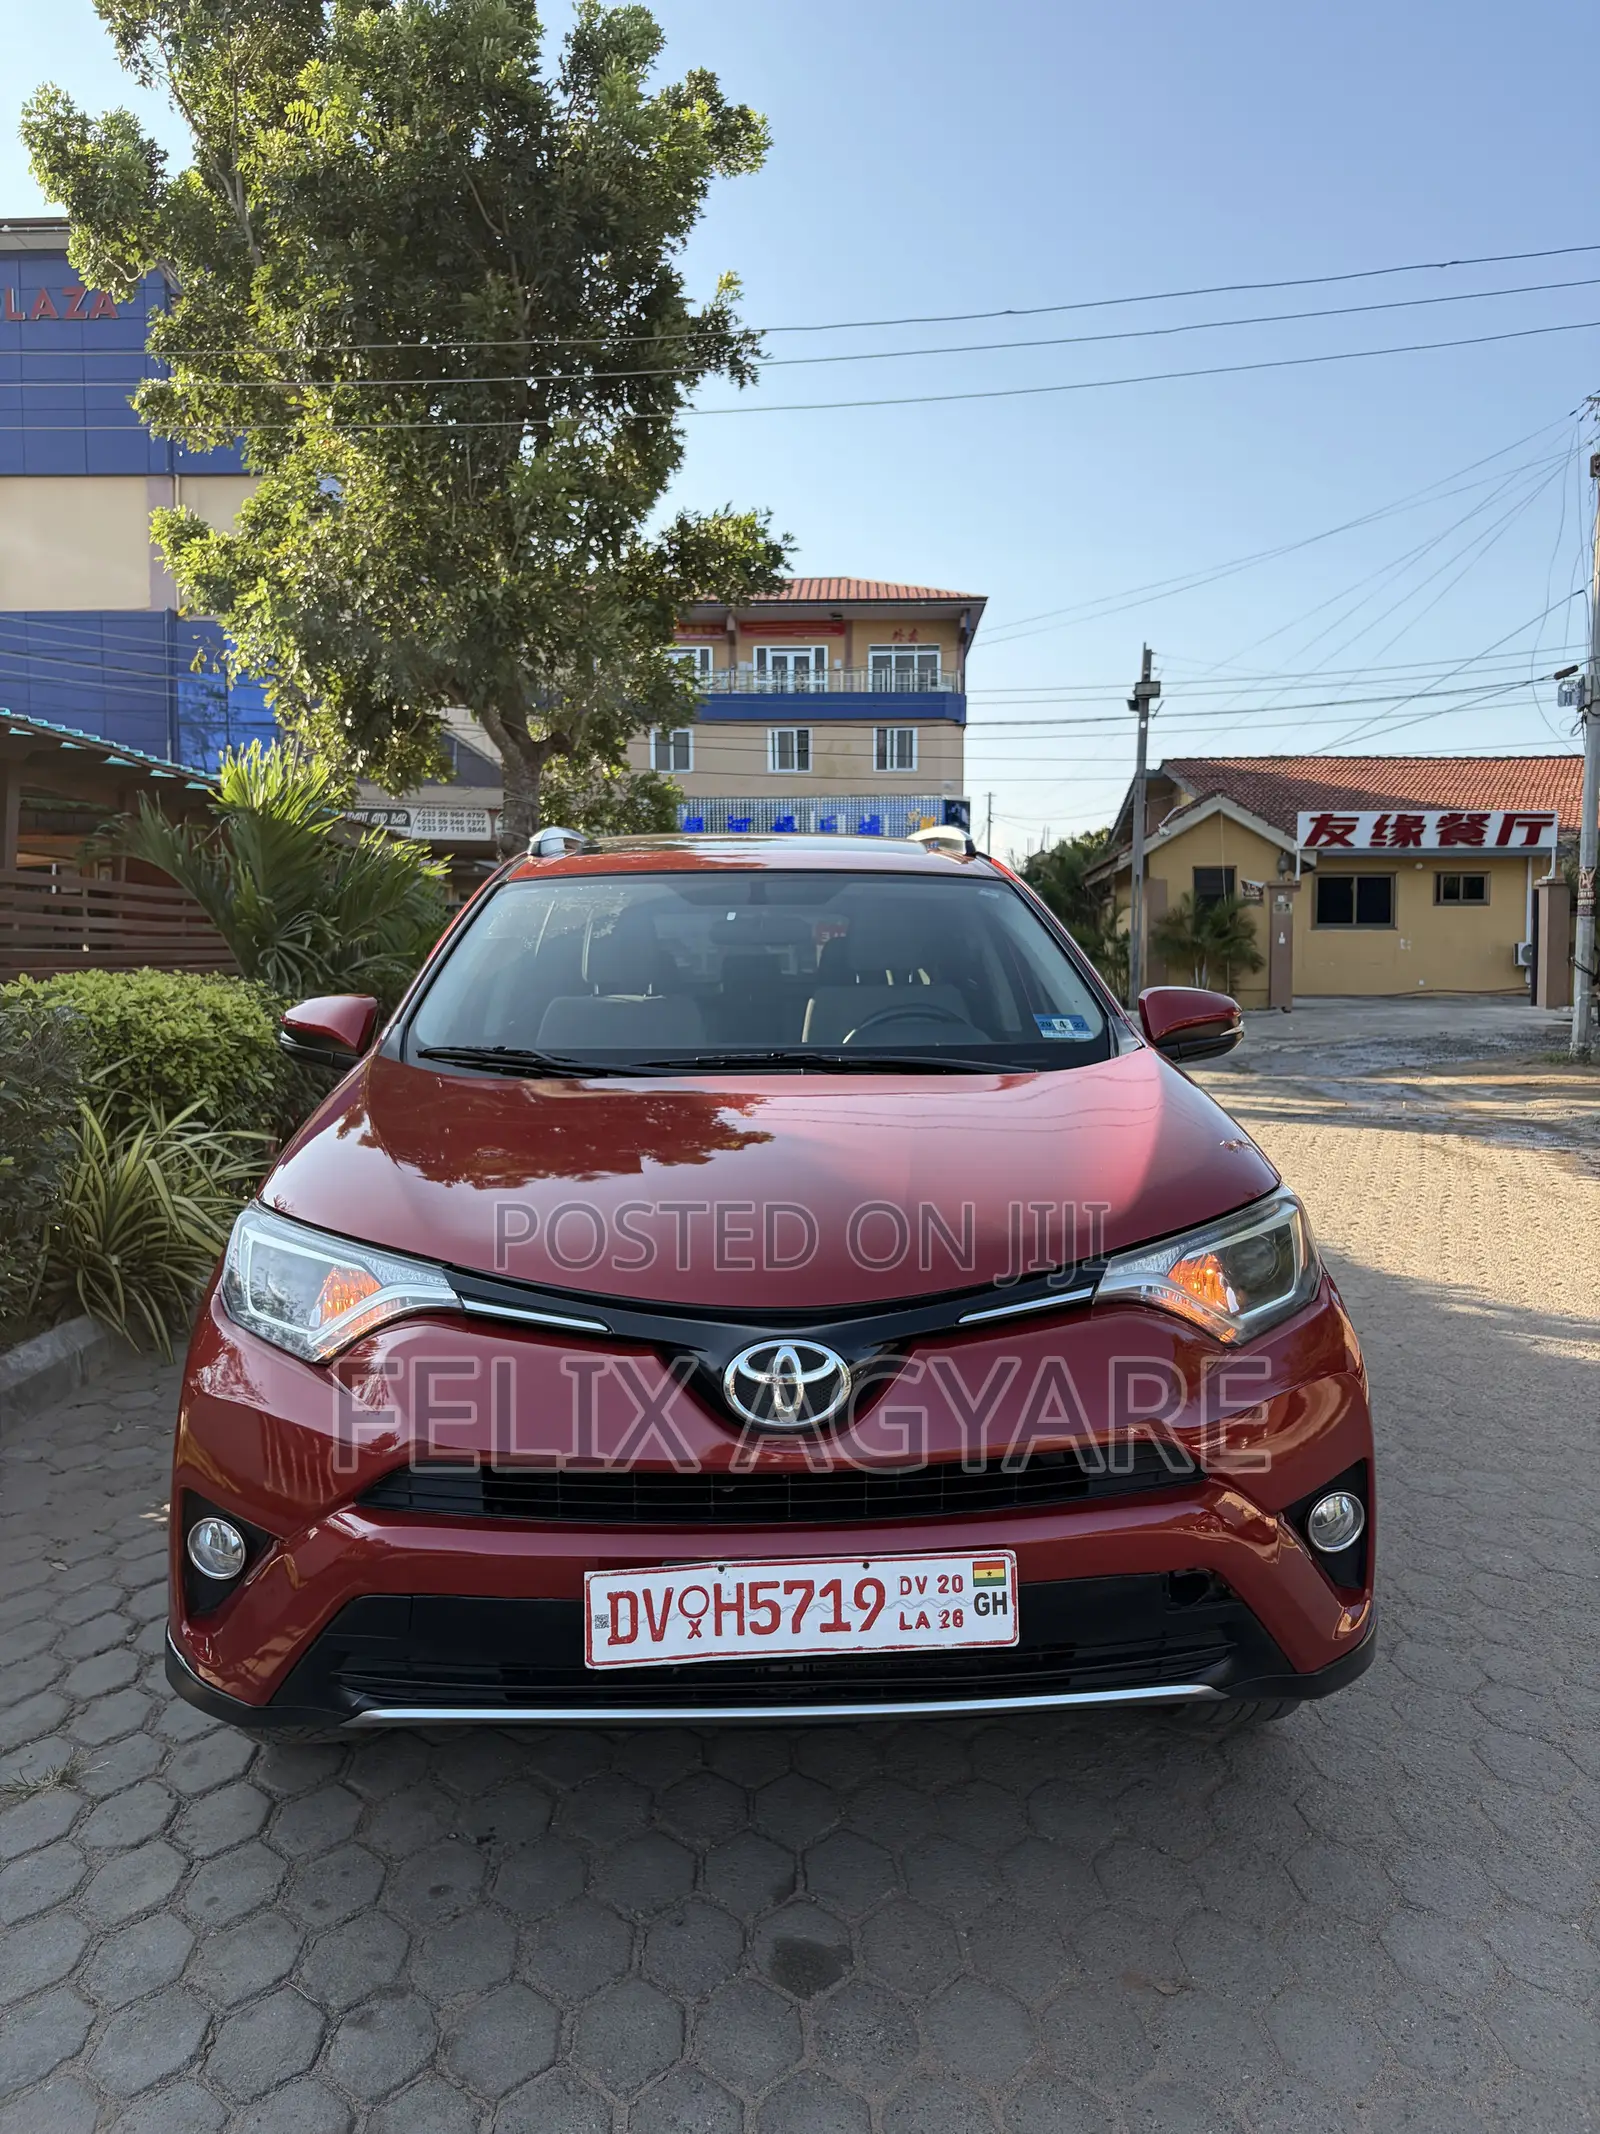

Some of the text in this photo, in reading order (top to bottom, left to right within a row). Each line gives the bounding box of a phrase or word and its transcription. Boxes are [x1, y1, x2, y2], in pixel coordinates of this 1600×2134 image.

[1303, 813, 1555, 848] 友缘餐厅
[899, 1573, 964, 1596] DV 20
[973, 1591, 1008, 1617] GH
[898, 1610, 931, 1631] LA
